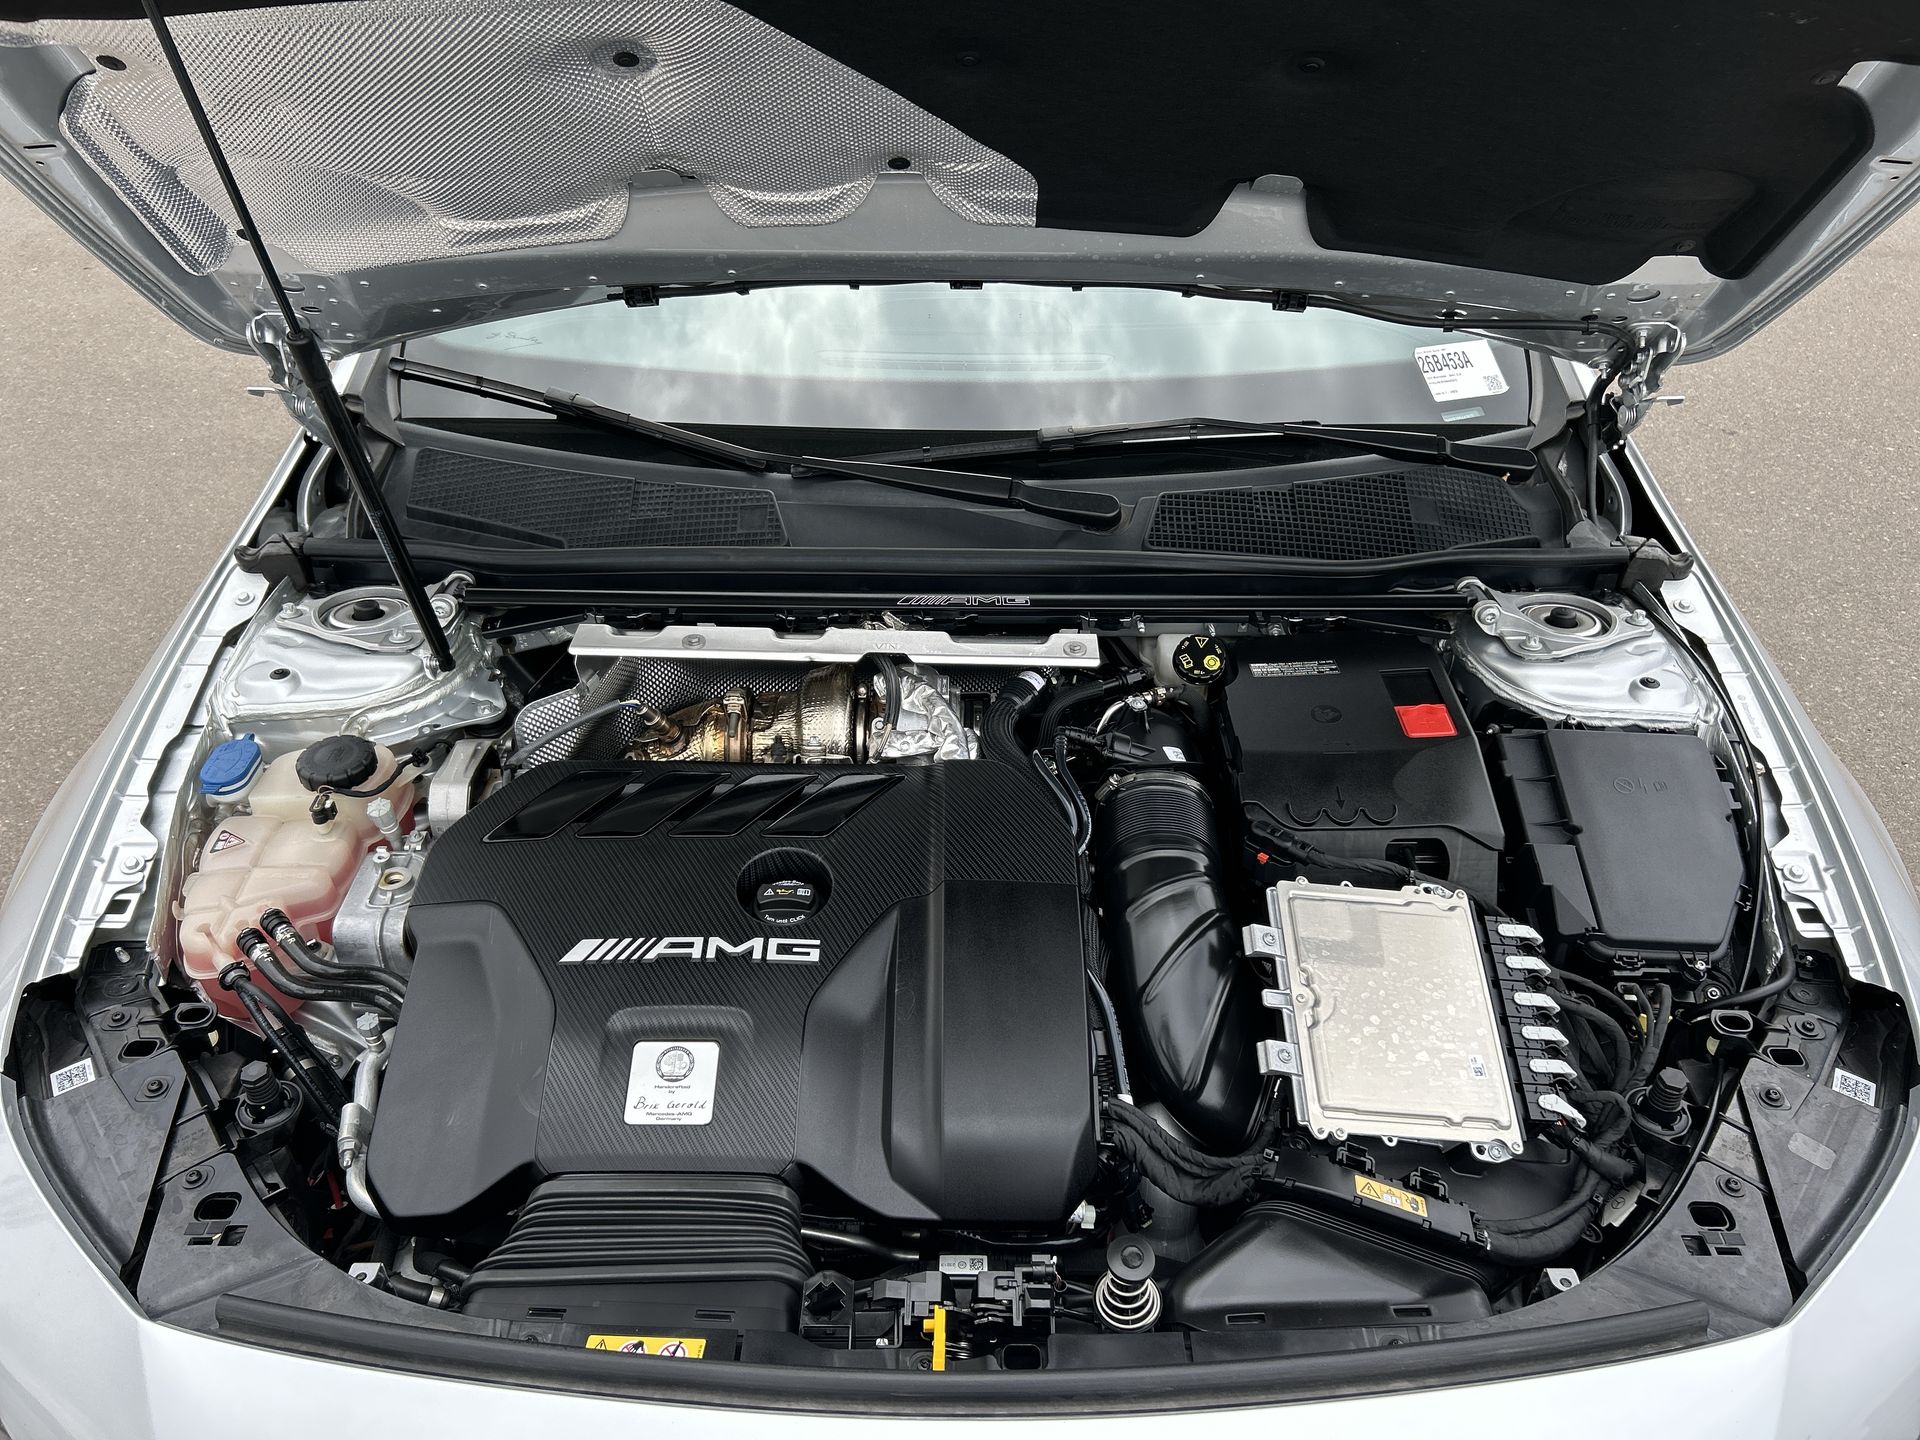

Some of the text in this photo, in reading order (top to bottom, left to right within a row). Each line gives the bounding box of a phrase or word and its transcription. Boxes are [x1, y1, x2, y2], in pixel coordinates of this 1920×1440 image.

[1417, 351, 1474, 374] 26B453A
[789, 914, 806, 923] CLICK
[642, 936, 821, 965] AMG
